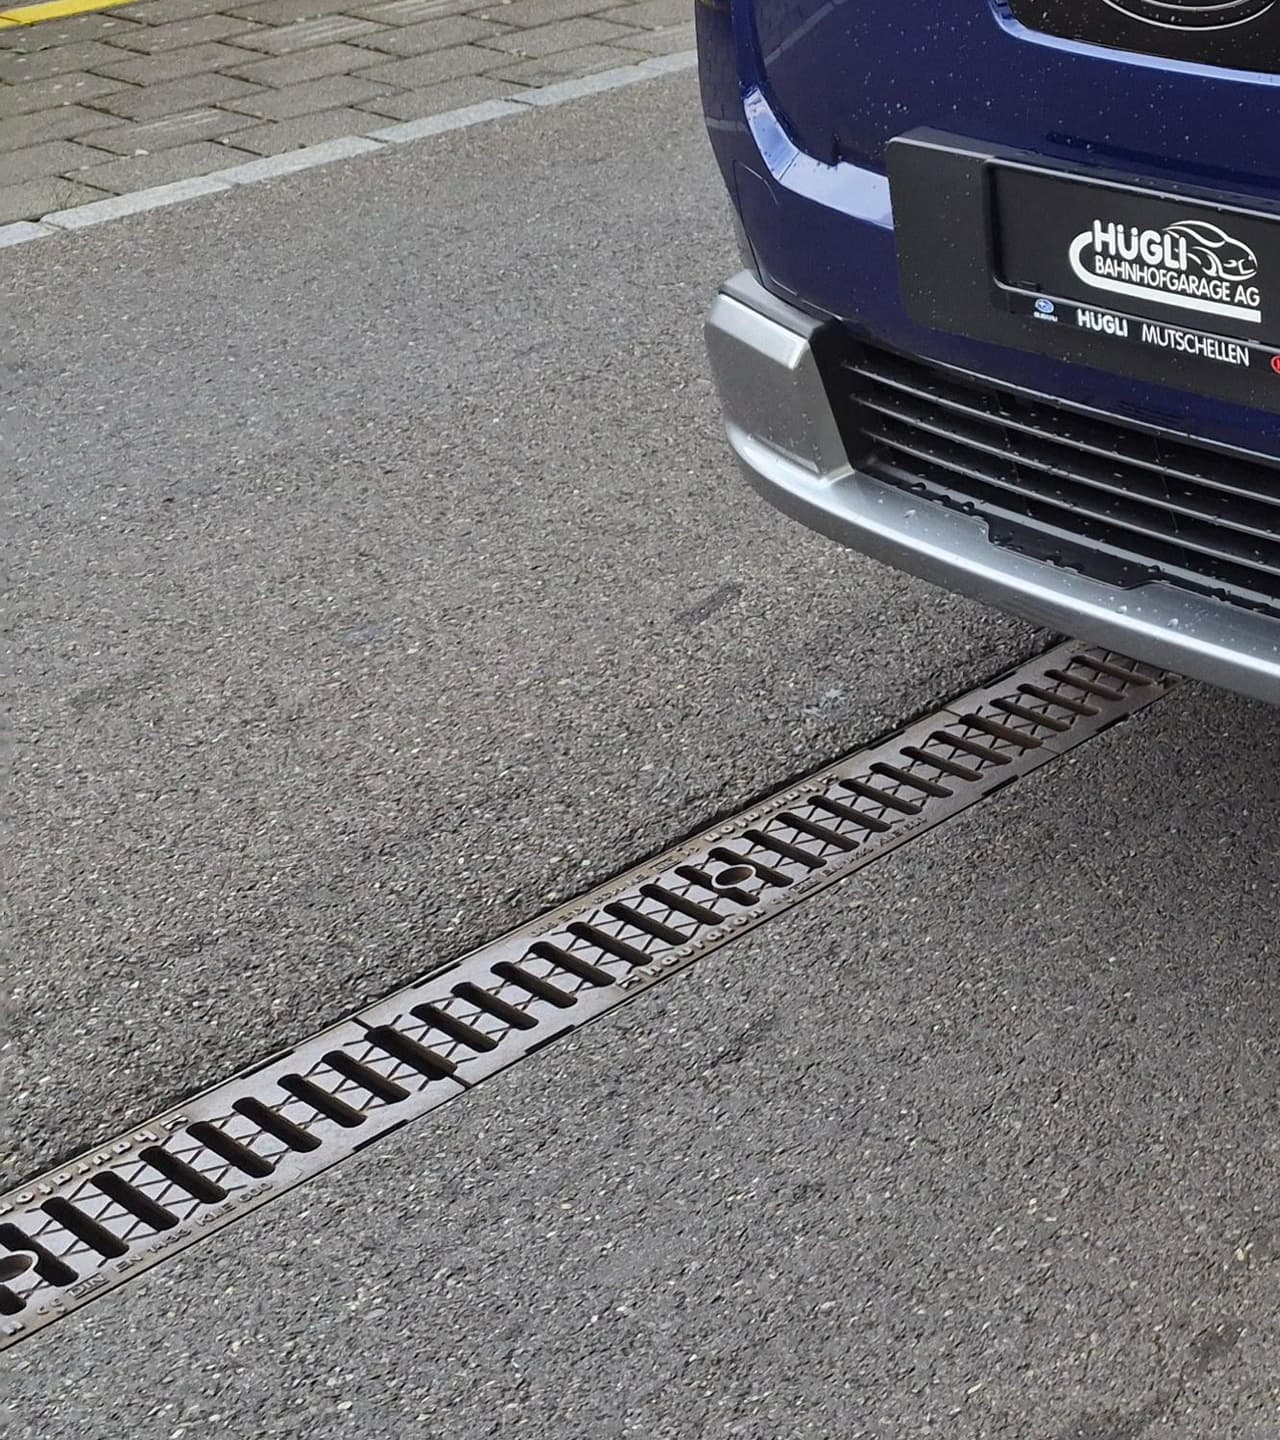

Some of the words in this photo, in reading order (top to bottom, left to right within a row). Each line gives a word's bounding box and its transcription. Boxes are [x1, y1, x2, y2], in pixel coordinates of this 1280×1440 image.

[1094, 254, 1231, 303] BAHNHOFGARAGE
[1234, 284, 1261, 307] AG
[1141, 323, 1250, 367] MUTSCHELLEN
